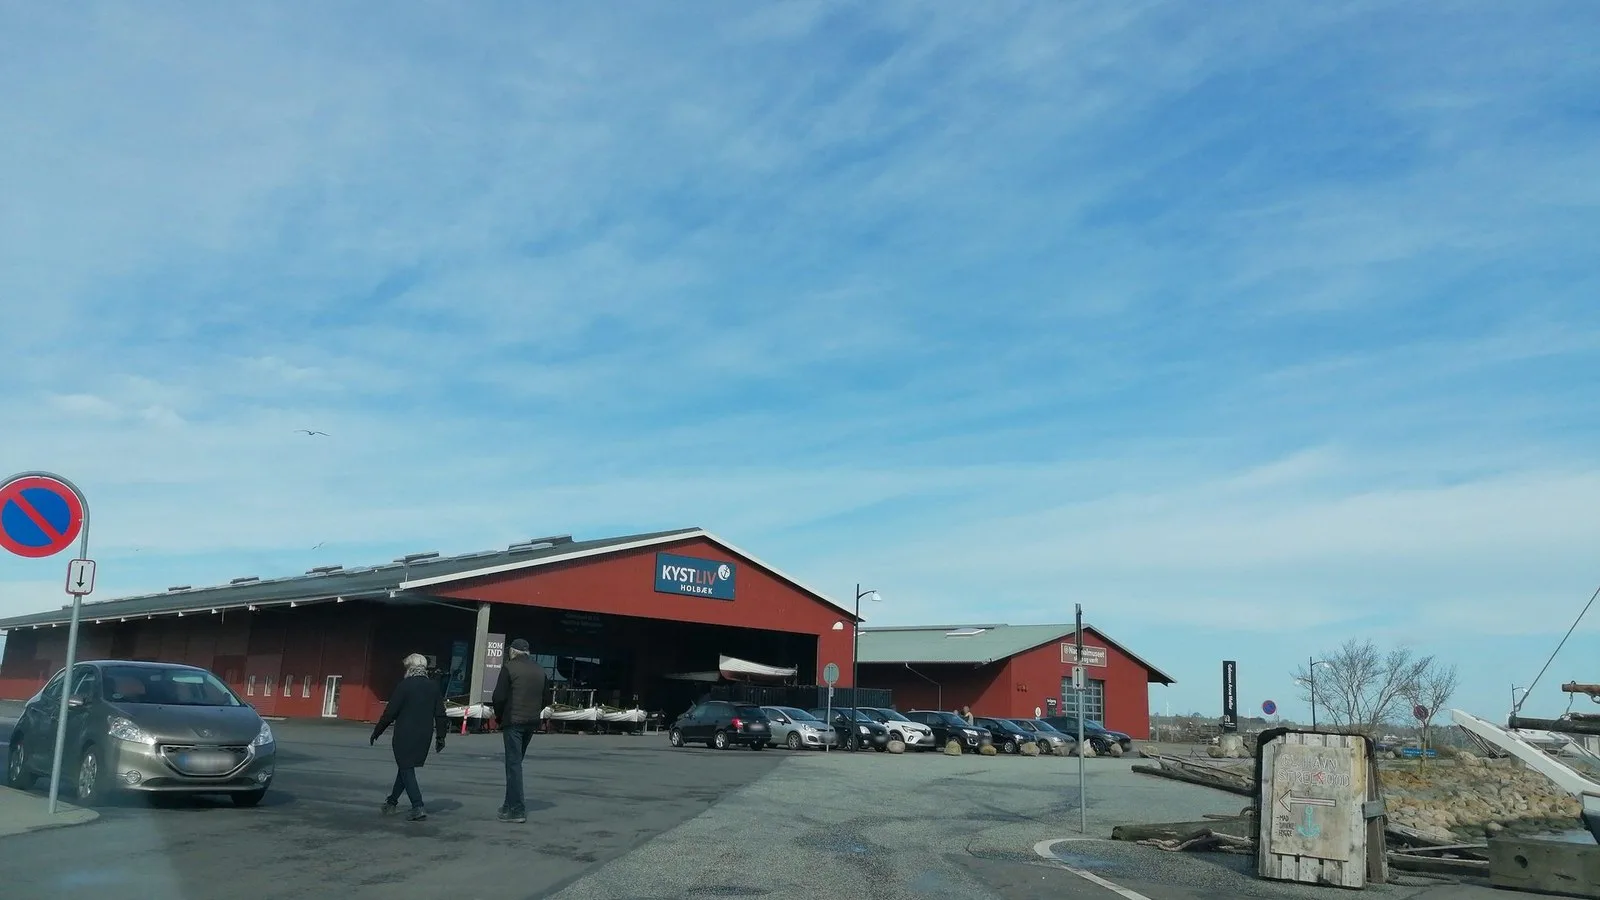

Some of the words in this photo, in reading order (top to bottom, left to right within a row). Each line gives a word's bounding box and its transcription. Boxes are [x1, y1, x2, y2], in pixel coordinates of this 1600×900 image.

[662, 564, 717, 586] KYSTLIV
[680, 584, 713, 595] HOLBÆK
[487, 641, 503, 649] KOM
[487, 648, 503, 657] IND
